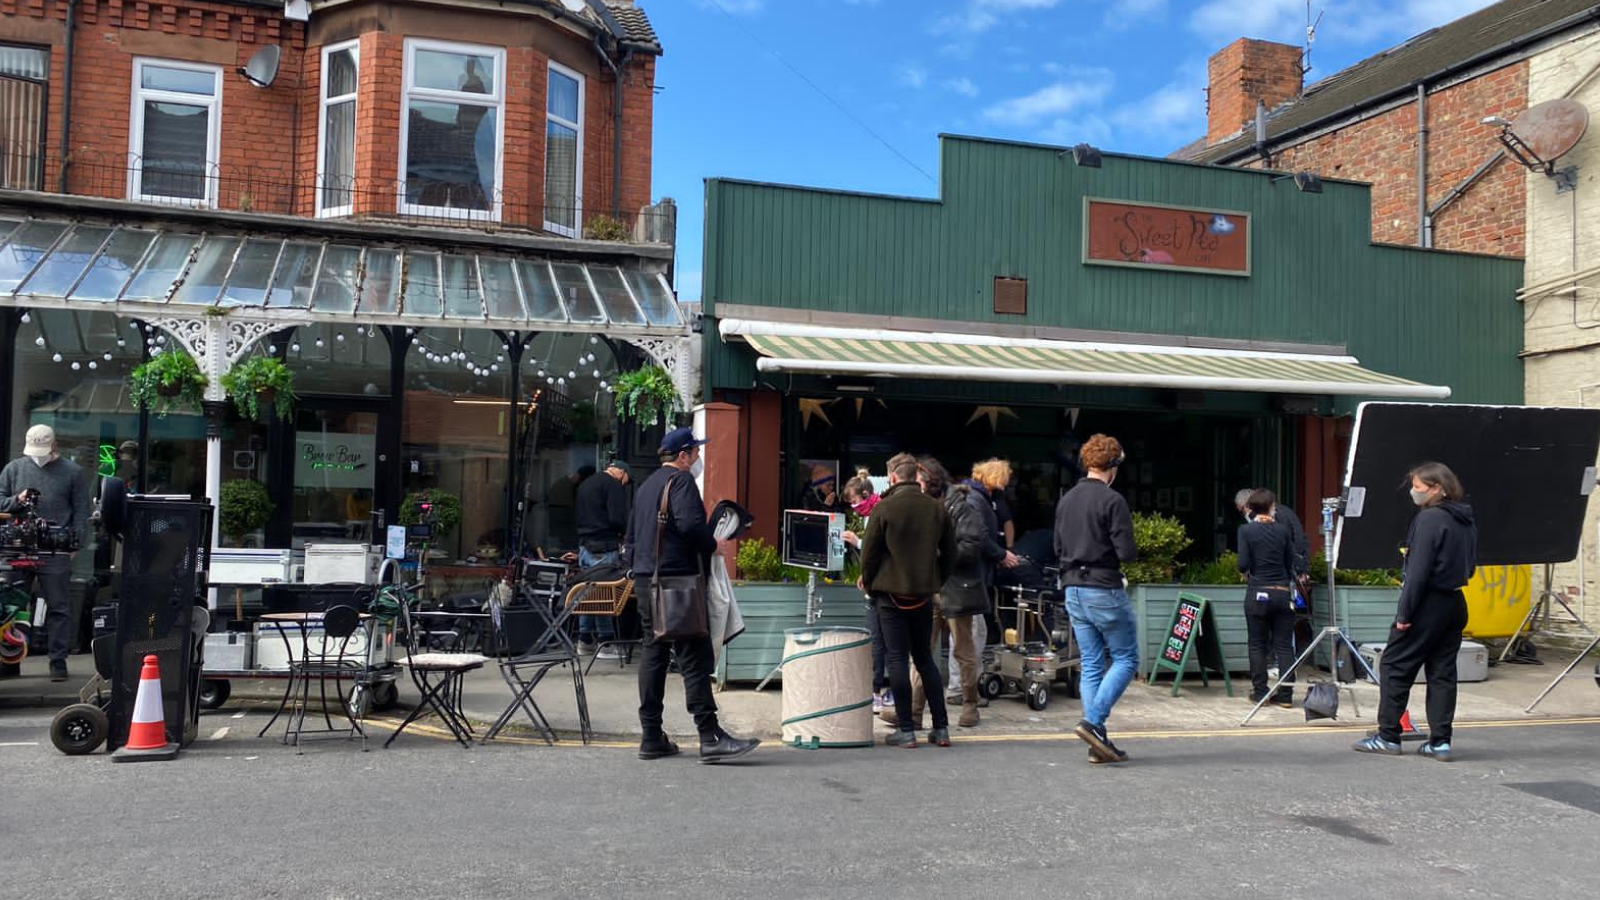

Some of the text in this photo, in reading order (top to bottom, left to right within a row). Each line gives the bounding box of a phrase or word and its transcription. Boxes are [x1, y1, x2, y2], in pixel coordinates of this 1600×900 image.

[1118, 211, 1219, 256] Sweet Pea
[303, 443, 361, 463] Brew Bar
[1179, 603, 1200, 620] SWEET
[1180, 615, 1192, 629] PEA
[1168, 637, 1185, 650] OPEN
